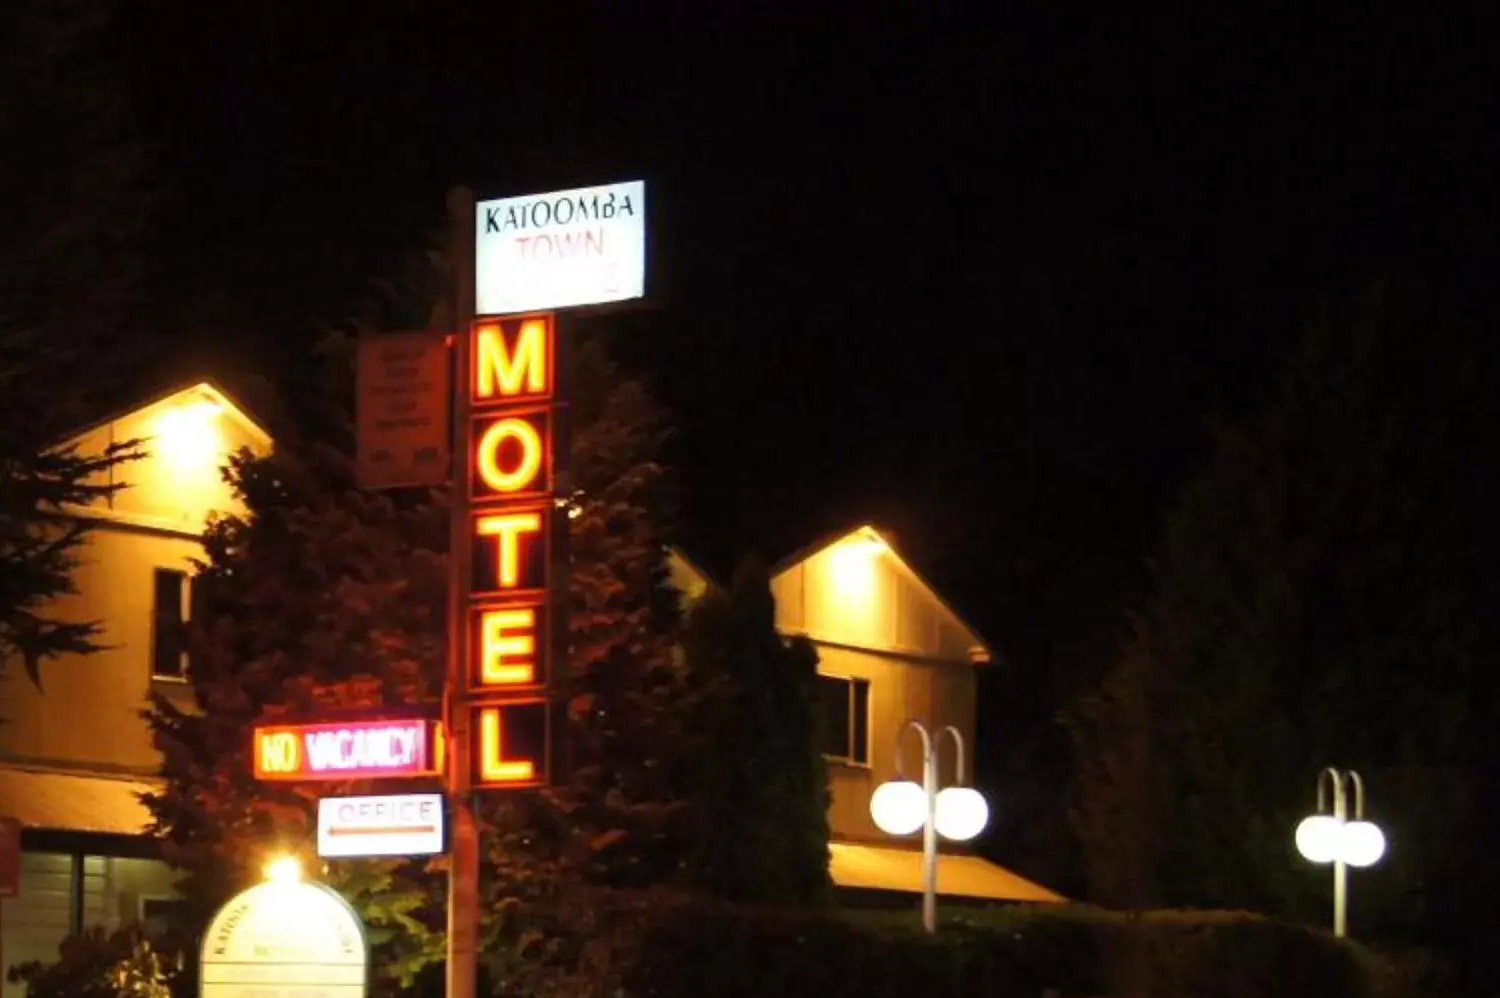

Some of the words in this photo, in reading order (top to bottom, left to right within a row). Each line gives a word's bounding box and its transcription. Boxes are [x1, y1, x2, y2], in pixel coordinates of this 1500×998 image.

[485, 192, 635, 234] KATOOMBA
[515, 227, 604, 262] TOWN
[476, 318, 546, 782] MOTEL
[261, 733, 297, 772] NO
[305, 726, 418, 771] VACANCY
[338, 801, 434, 825] OFFICE
